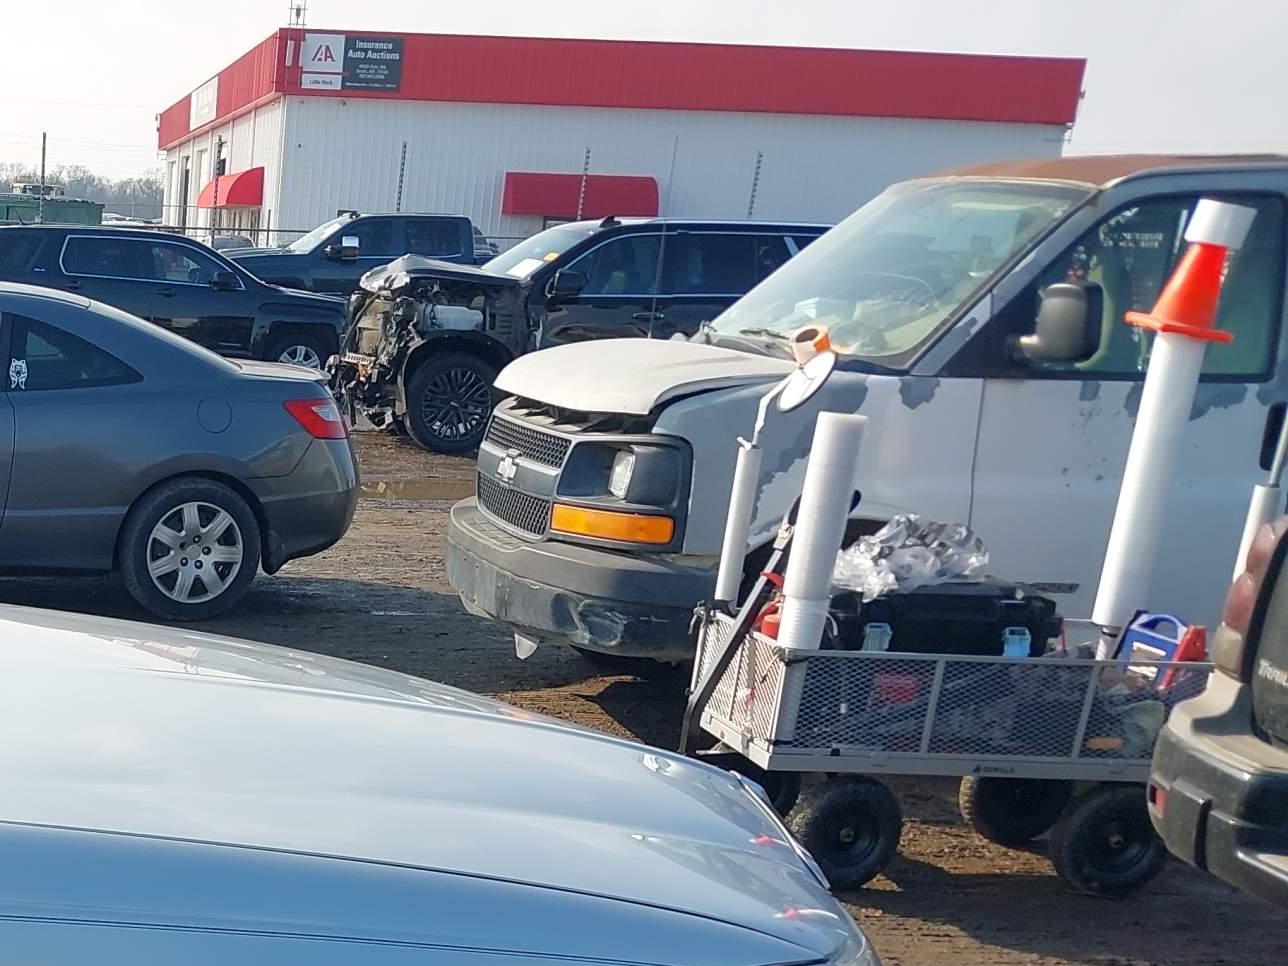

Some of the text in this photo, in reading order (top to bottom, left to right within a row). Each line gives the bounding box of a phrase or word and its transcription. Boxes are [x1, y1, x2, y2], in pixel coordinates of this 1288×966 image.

[355, 39, 393, 50] Insurance
[348, 49, 400, 60] Auto Auctions
